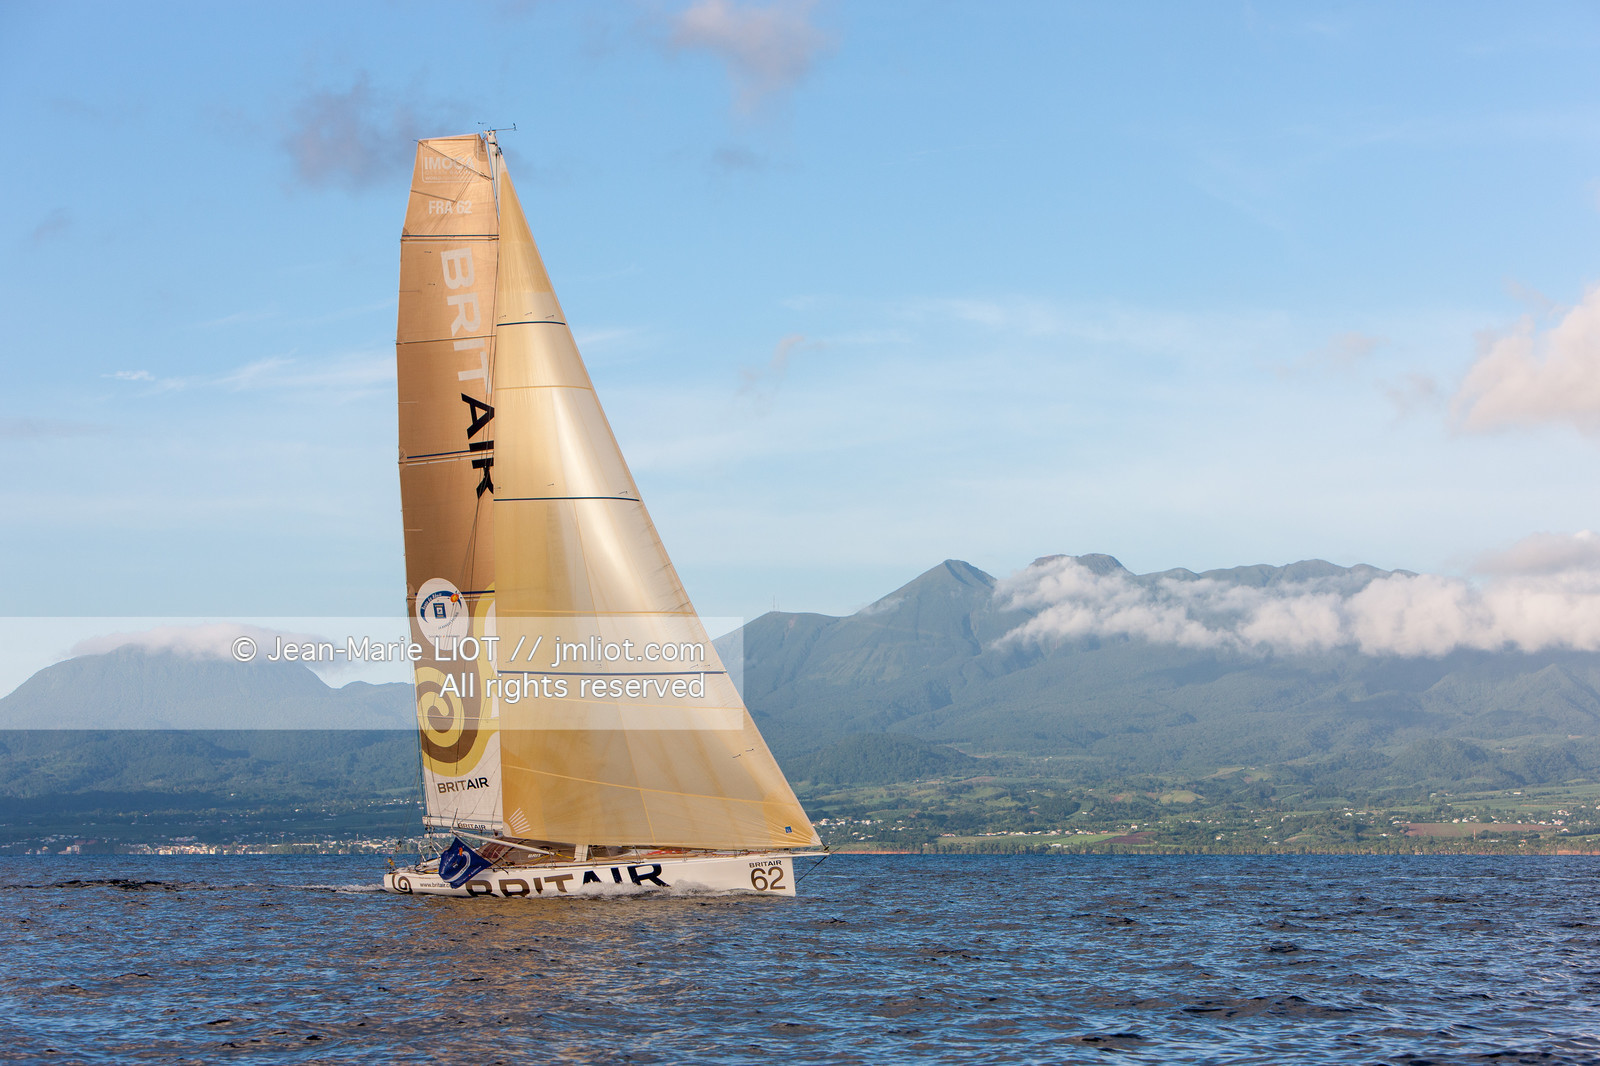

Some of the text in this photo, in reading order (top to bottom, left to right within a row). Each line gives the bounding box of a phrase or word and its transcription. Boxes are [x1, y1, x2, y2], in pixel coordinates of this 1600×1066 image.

[424, 156, 475, 170] IMOCA
[428, 200, 473, 215] FRA 62
[437, 777, 489, 793] BRITAIR
[749, 860, 782, 868] BRITAIR
[751, 866, 786, 891] 62
